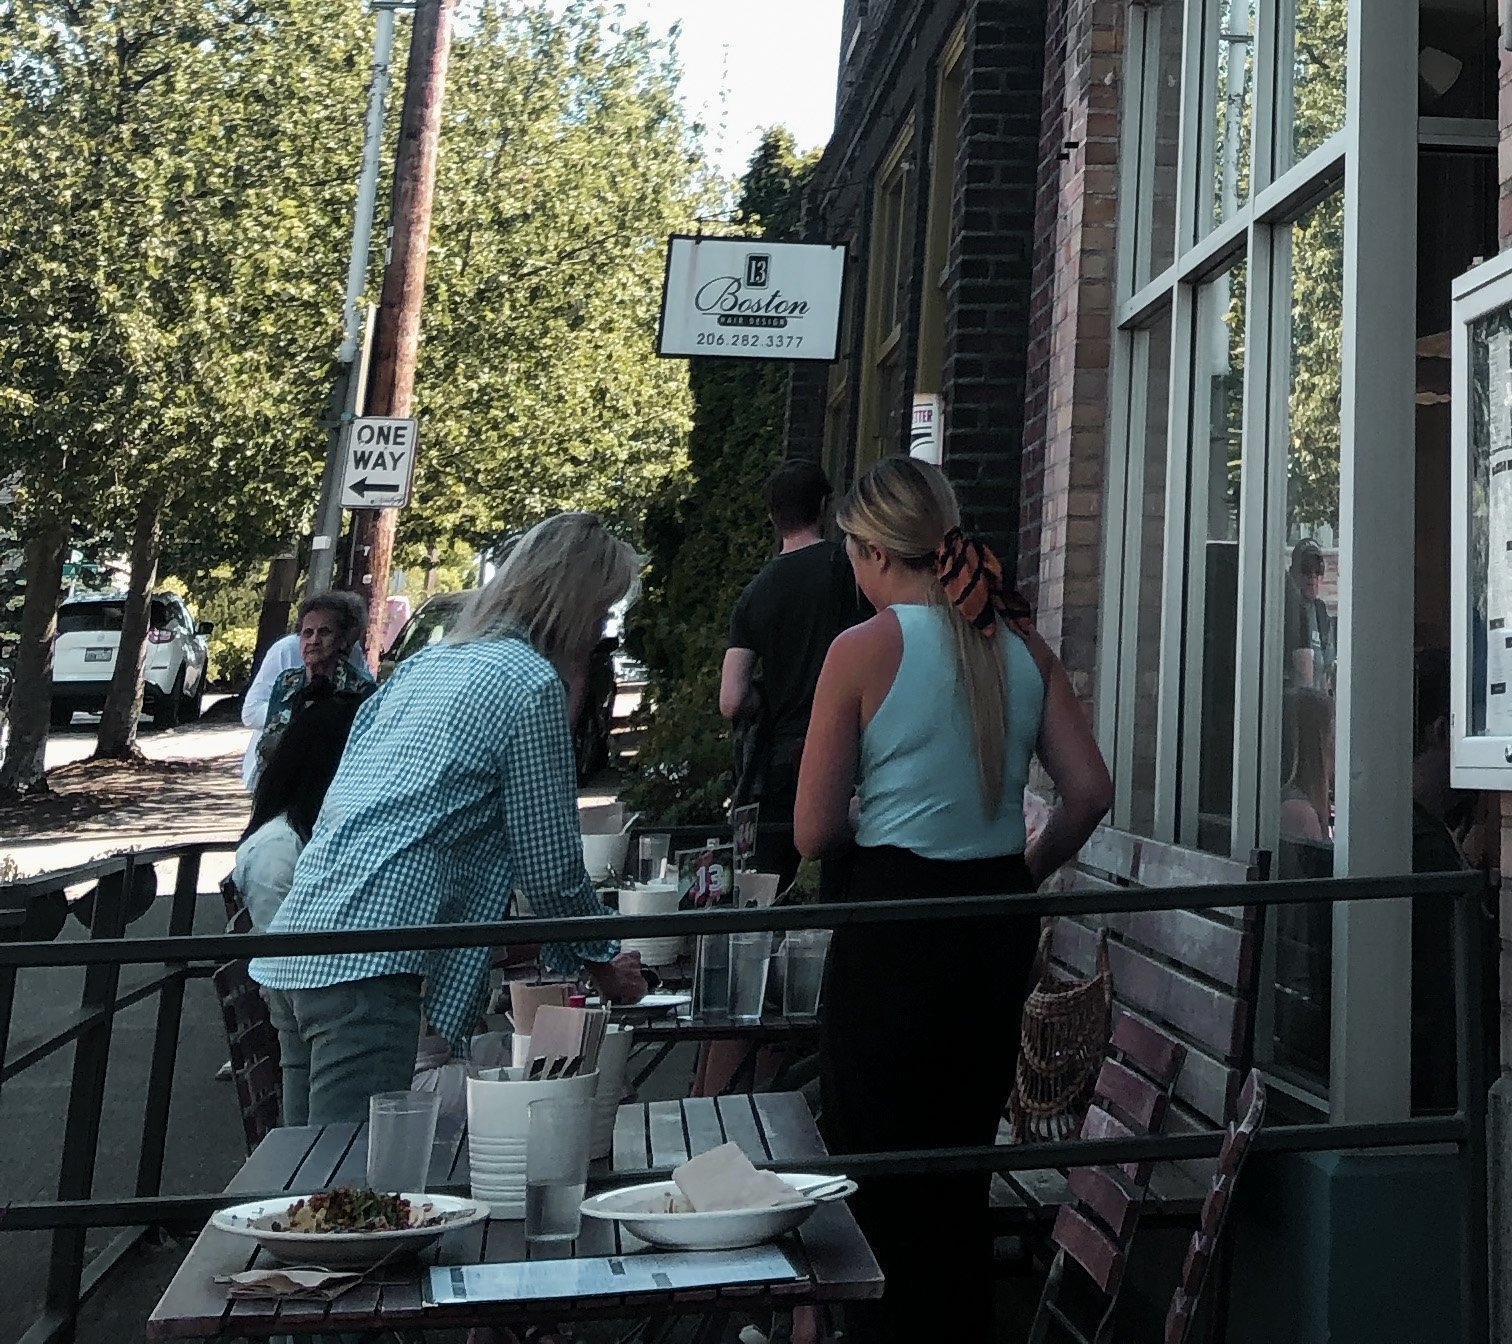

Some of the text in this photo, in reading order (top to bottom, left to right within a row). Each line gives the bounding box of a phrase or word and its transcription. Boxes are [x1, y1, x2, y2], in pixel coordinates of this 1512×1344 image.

[749, 259, 766, 284] 13
[695, 275, 811, 315] Boston
[696, 332, 804, 349] 206.282.3377
[357, 424, 408, 446] ONE
[353, 450, 406, 471] WAY
[695, 863, 724, 893] 13
